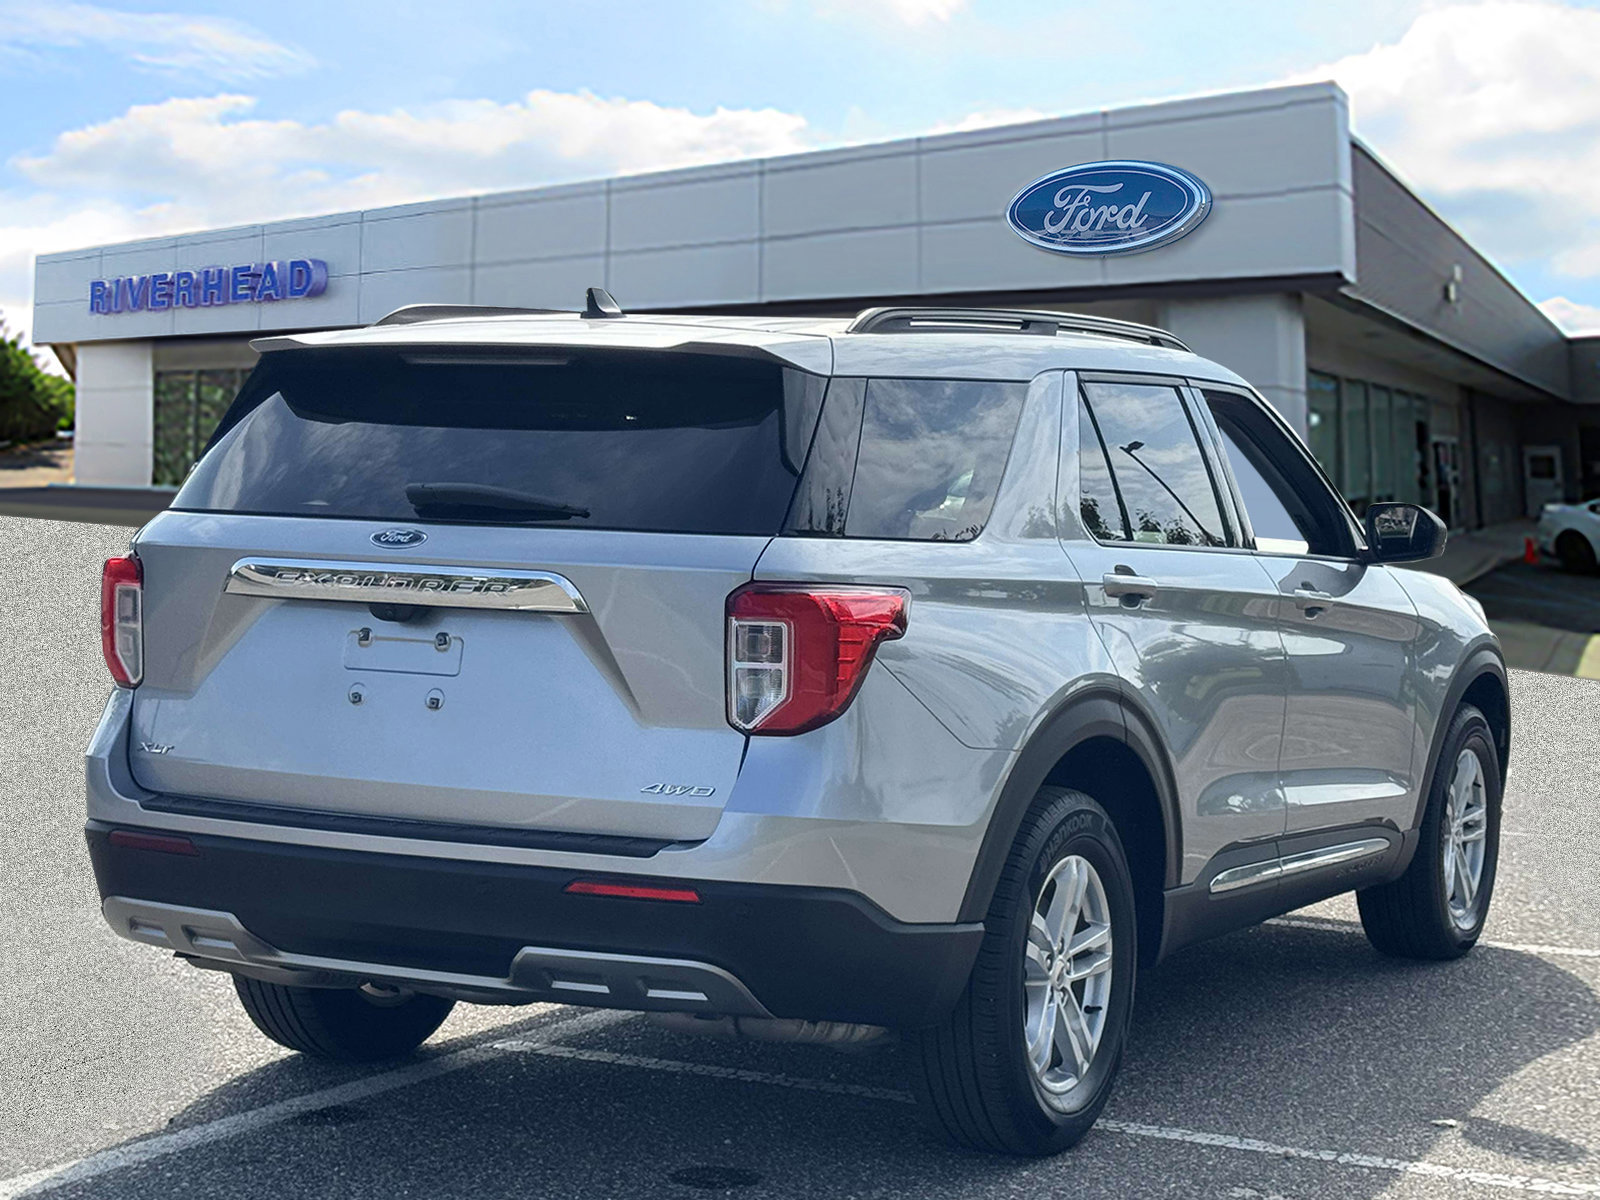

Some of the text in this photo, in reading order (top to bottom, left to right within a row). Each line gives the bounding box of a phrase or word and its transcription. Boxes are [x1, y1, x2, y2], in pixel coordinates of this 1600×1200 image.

[1043, 182, 1152, 233] Ford
[90, 259, 327, 314] RIVERHEAD
[380, 529, 414, 543] Ford
[272, 571, 516, 597] EXPLORER
[137, 741, 175, 755] XLT
[640, 782, 716, 797] 4WD
